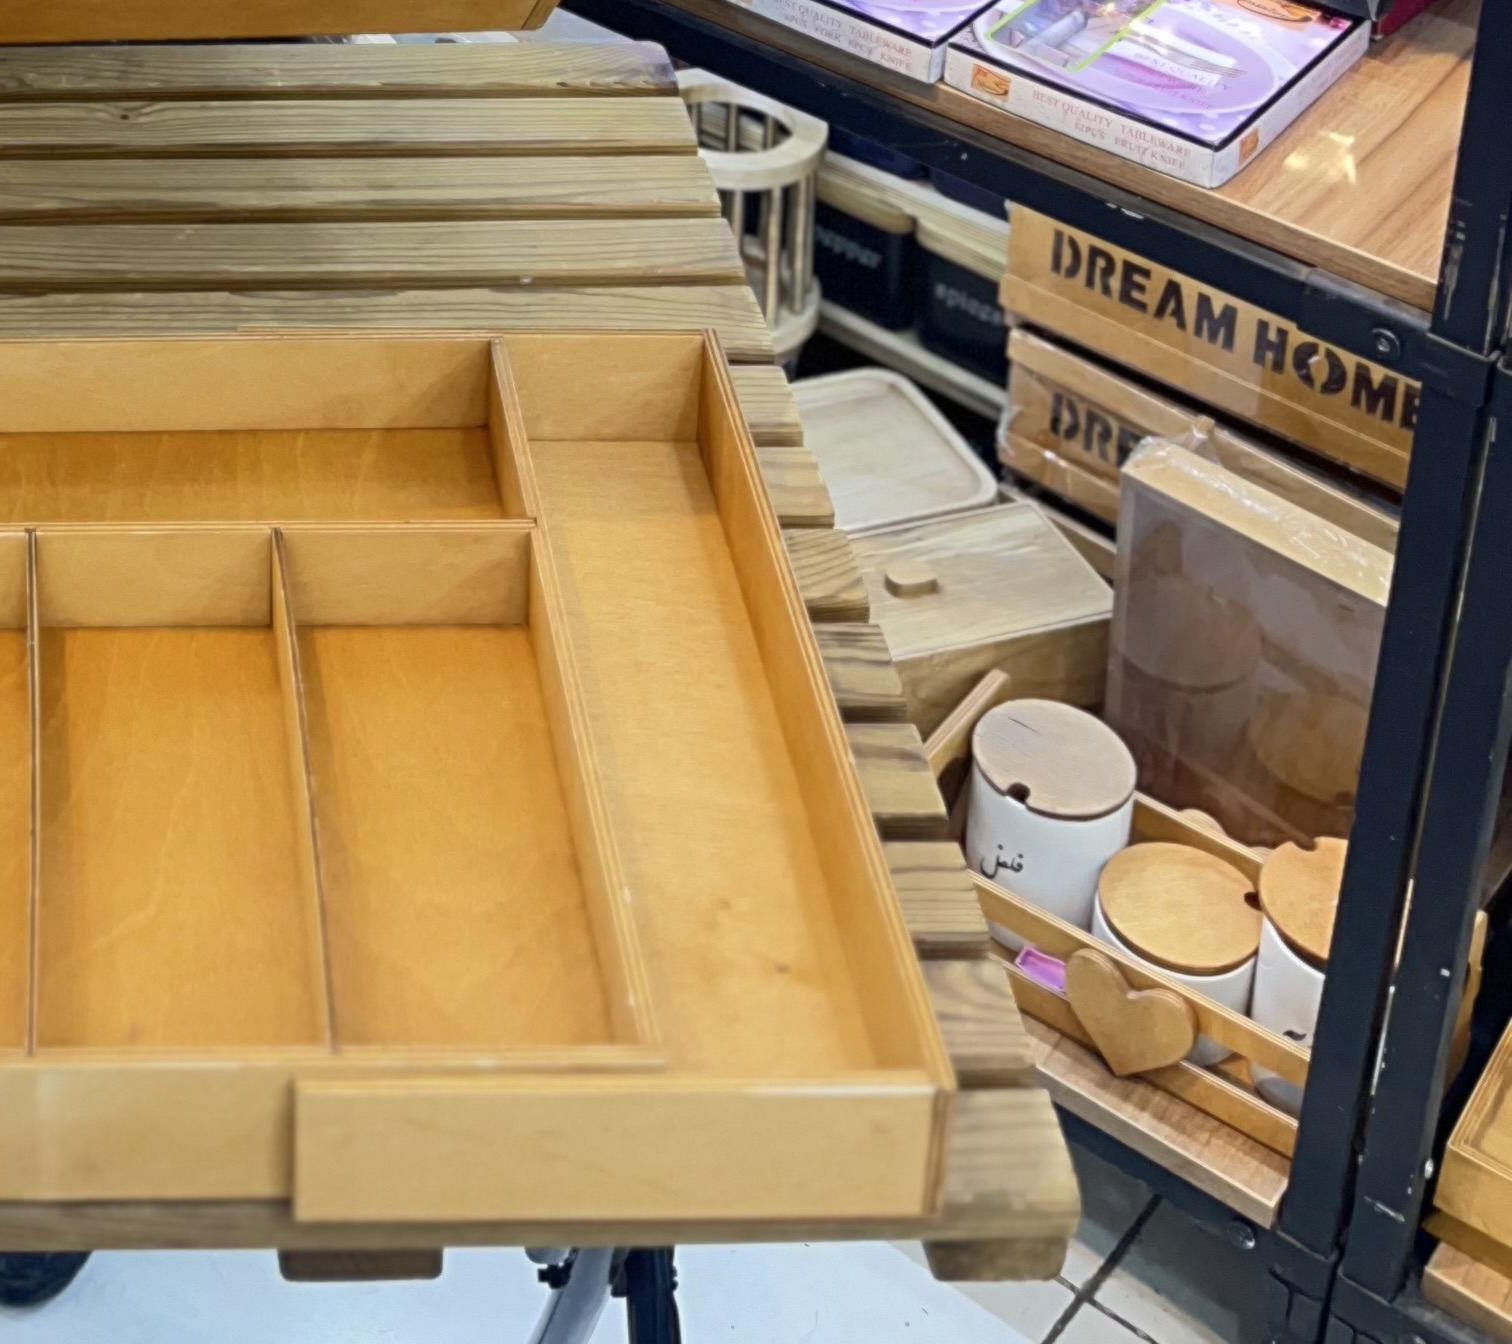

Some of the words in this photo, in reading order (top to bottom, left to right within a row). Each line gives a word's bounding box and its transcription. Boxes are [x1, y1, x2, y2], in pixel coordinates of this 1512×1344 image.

[1119, 123, 1192, 159] TABLEWARE
[1050, 228, 1238, 354] DREAM
[1253, 318, 1424, 432] HOME
[1050, 392, 1141, 466] DRE
